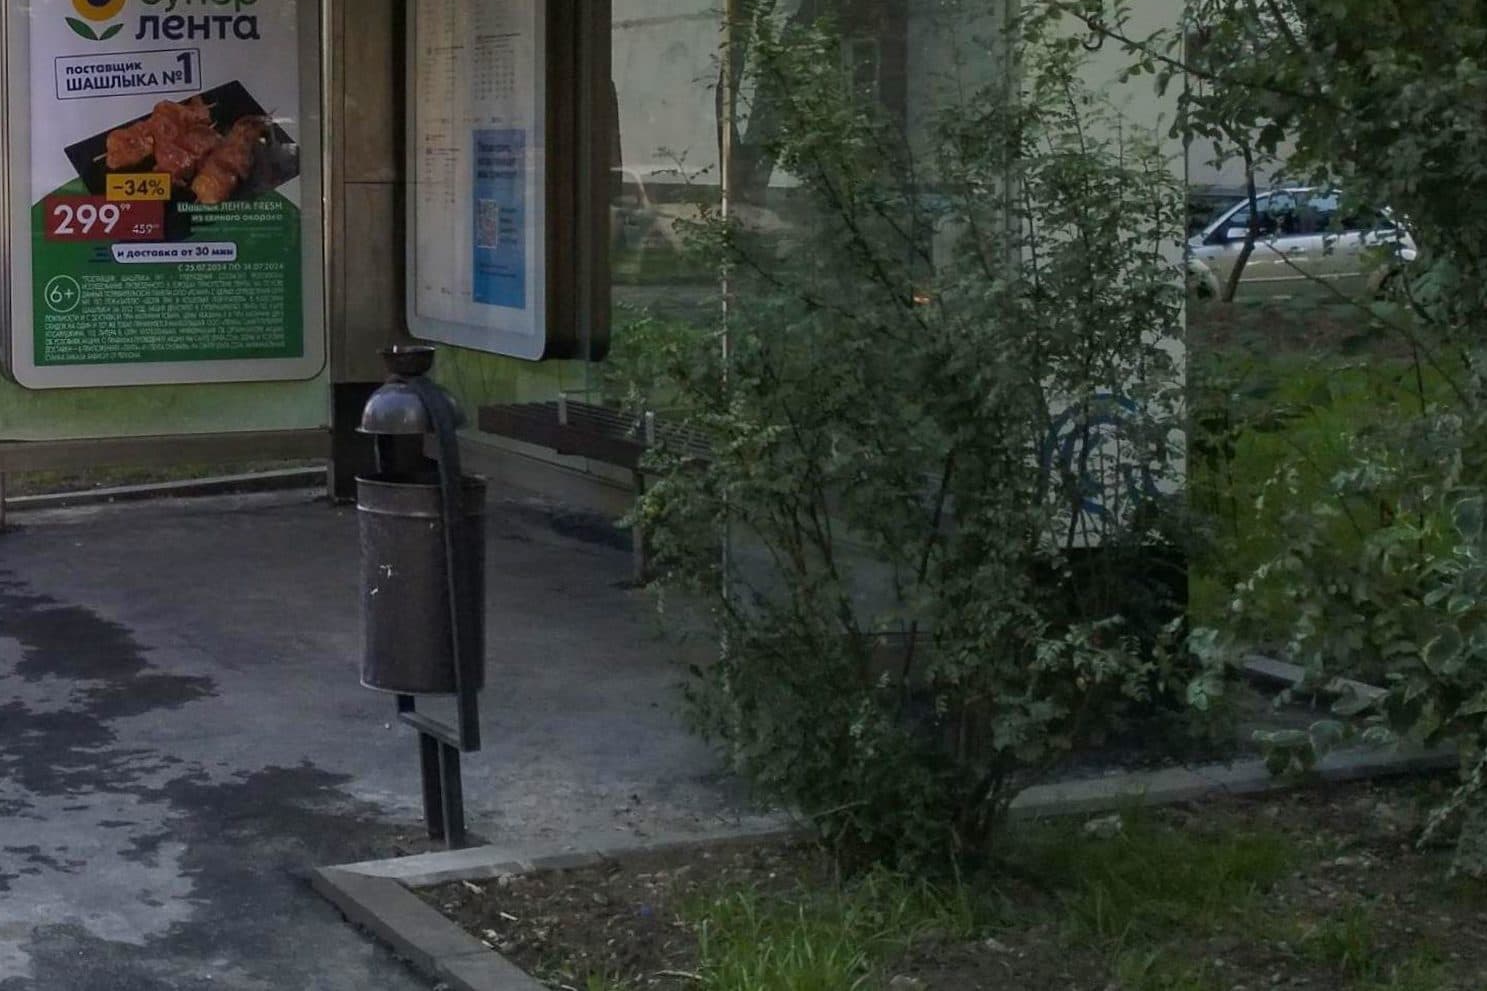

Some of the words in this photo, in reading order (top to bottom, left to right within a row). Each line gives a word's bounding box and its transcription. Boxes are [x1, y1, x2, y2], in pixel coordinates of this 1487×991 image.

[135, 14, 260, 40] лента
[65, 61, 142, 75] поставщик
[65, 72, 159, 92] ШАШЛЫКА
[53, 203, 120, 235] 299
[126, 248, 178, 258] доставка
[181, 248, 193, 256] от
[195, 246, 209, 256] 30
[50, 284, 75, 304] 6+
